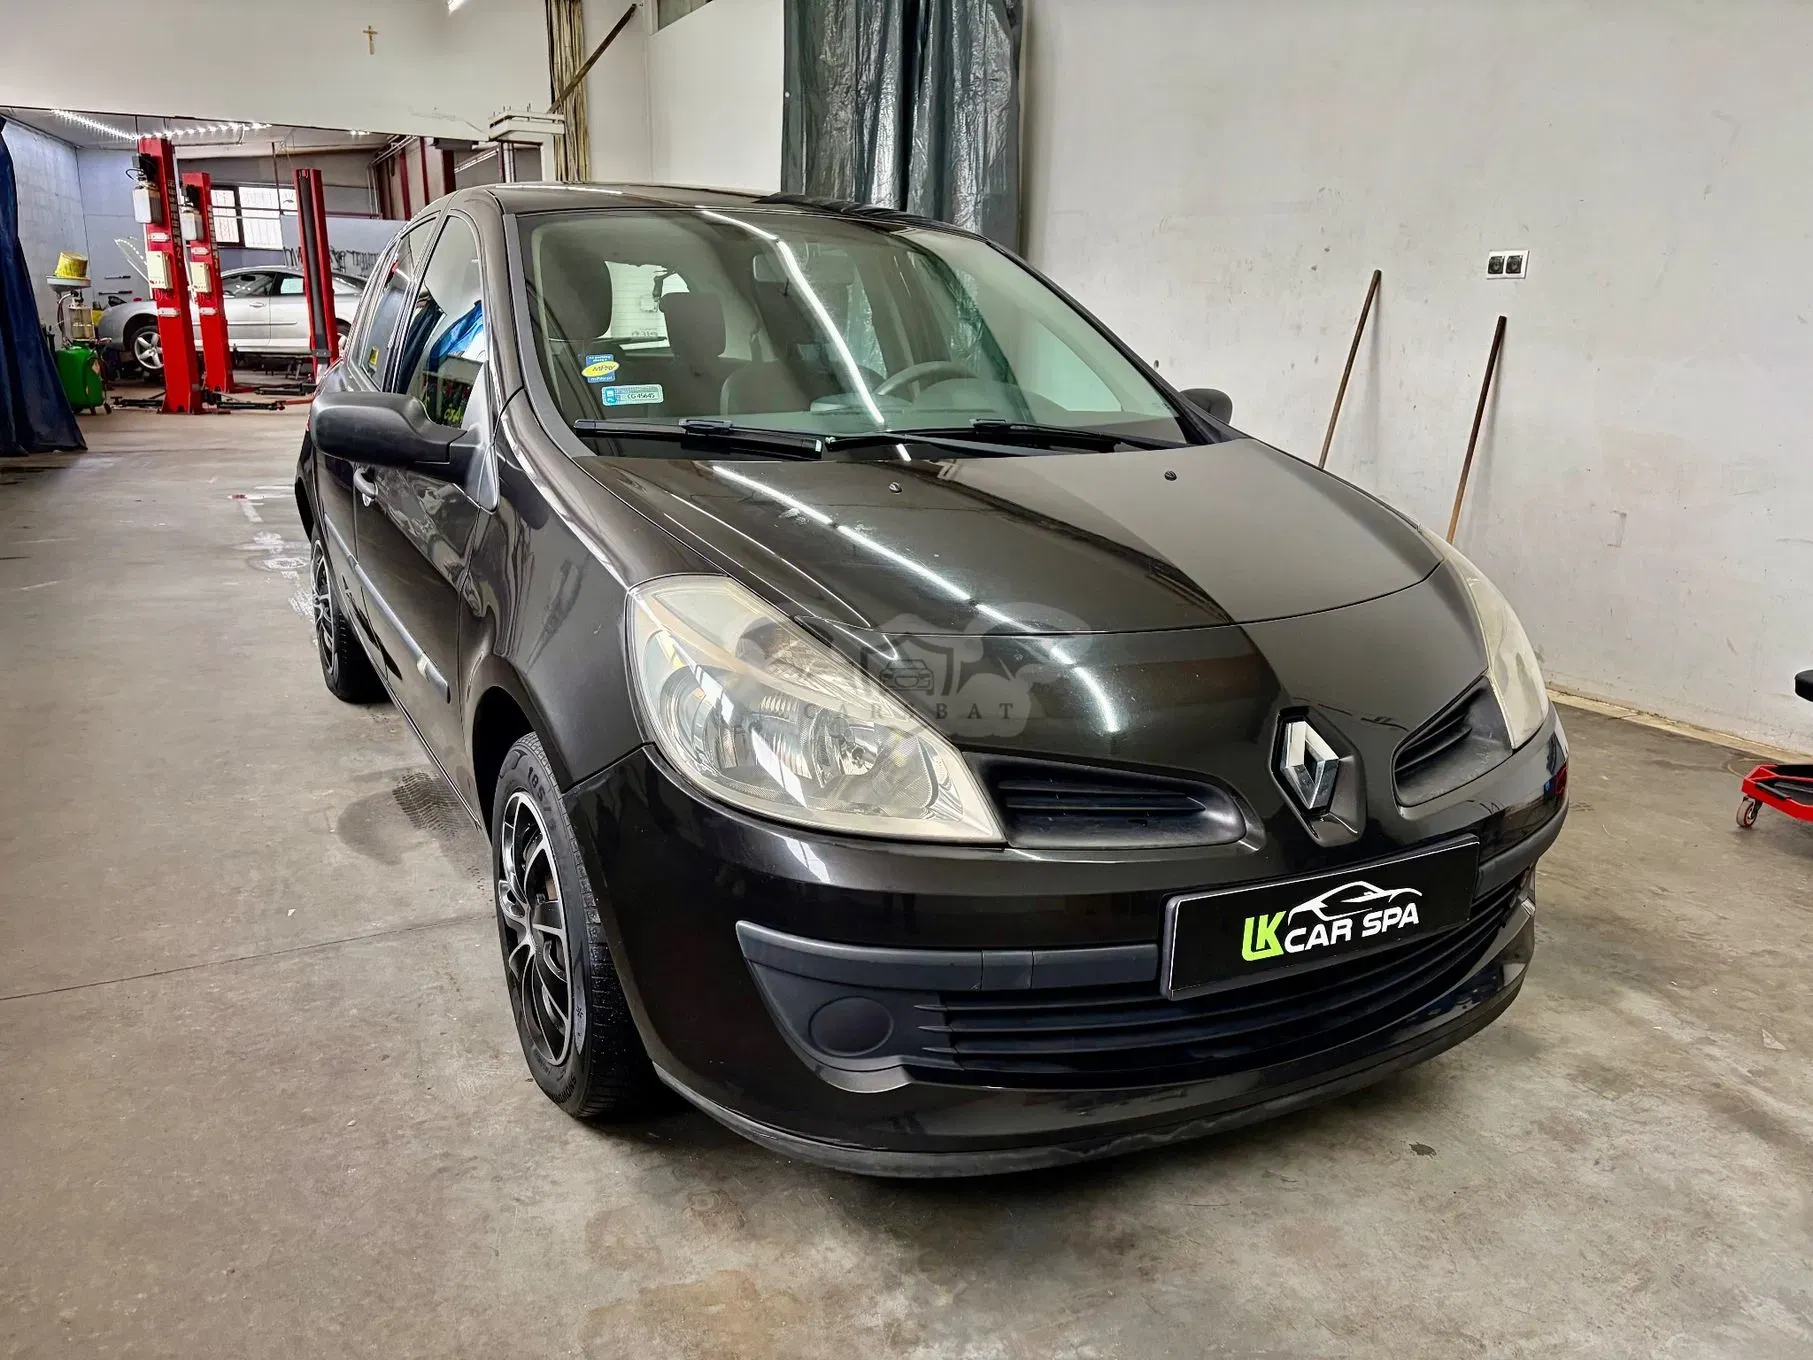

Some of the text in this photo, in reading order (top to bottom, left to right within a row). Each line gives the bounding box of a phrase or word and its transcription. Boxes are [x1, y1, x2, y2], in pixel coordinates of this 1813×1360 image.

[1241, 903, 1419, 961] LK CAR SPA
